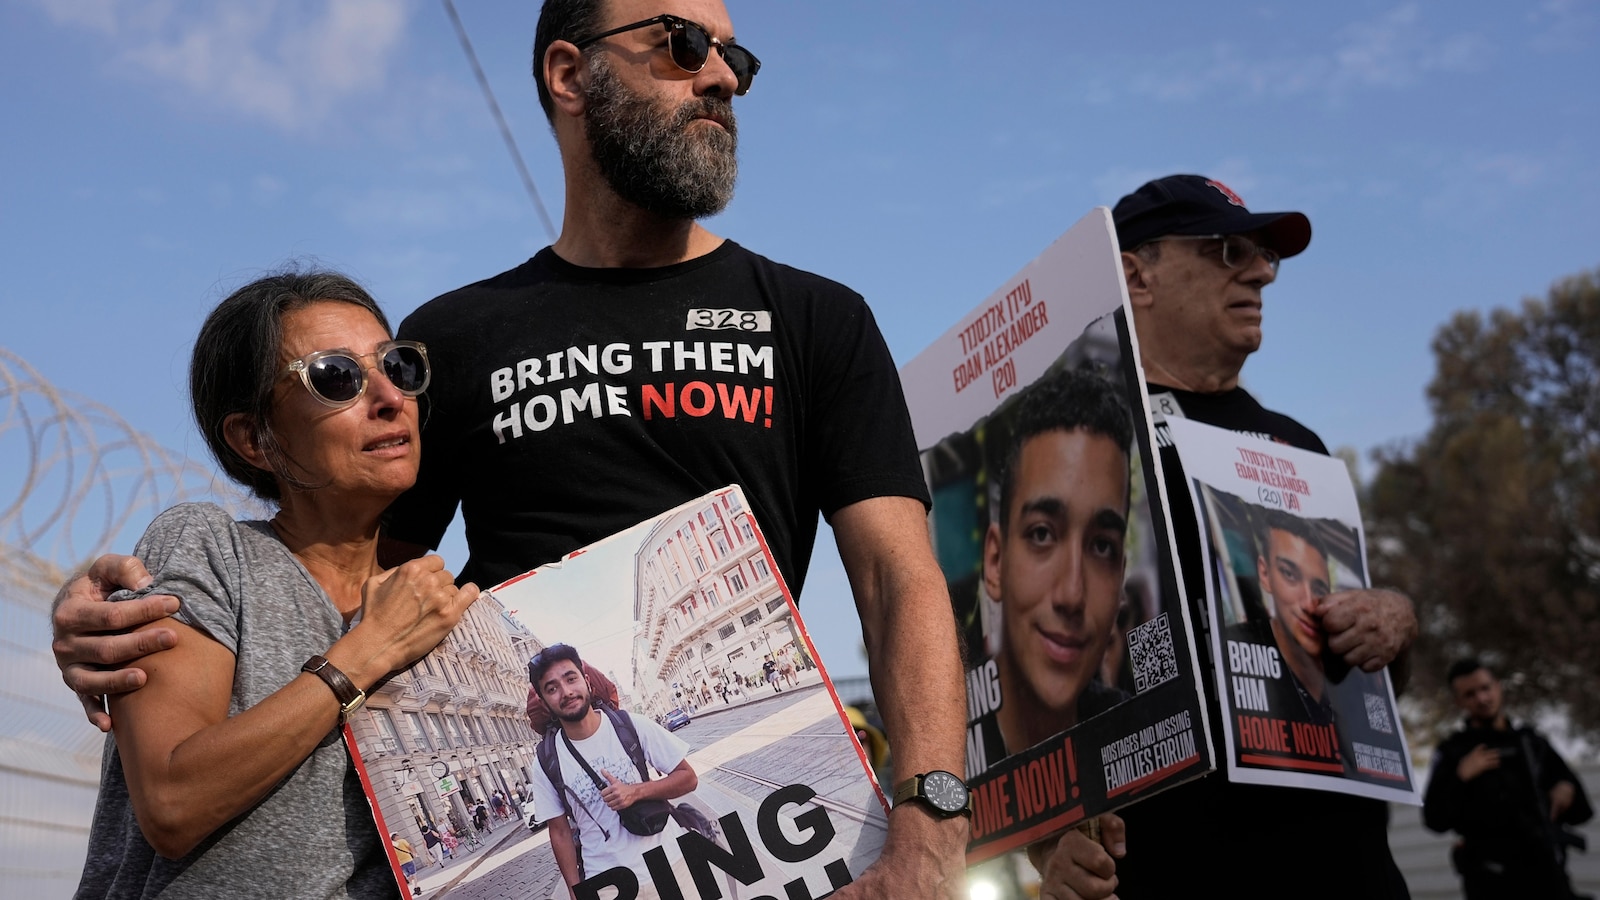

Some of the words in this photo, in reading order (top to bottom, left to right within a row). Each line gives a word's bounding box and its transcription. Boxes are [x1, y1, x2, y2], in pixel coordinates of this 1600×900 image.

[693, 309, 758, 331] 328
[958, 300, 1007, 356] אלכסנדר
[1006, 278, 1032, 322] עידן
[490, 343, 632, 404] BRING
[642, 340, 774, 380] THEM
[952, 352, 983, 394] EDAN
[984, 300, 1049, 371] ALEXANDER
[991, 356, 1018, 399] (20)
[492, 382, 632, 445] HOME
[641, 380, 774, 429] NOW!
[1234, 462, 1261, 482] EDAN
[1260, 469, 1311, 497] ALEXANDER
[1257, 485, 1282, 507] (20)
[1227, 640, 1281, 680] BRING
[966, 658, 1002, 724] ING
[1232, 676, 1270, 712] HIM
[1100, 732, 1139, 766] HOSTAGES
[1138, 725, 1156, 750] AND
[1154, 709, 1192, 742] MISSING
[1104, 747, 1154, 793] FAMILIES
[1153, 728, 1197, 772] FORUM
[1237, 715, 1292, 753] HOME
[1291, 720, 1342, 760] NOW!
[970, 773, 1014, 841] OME
[1012, 736, 1080, 823] NOW!
[572, 783, 837, 900] ING
